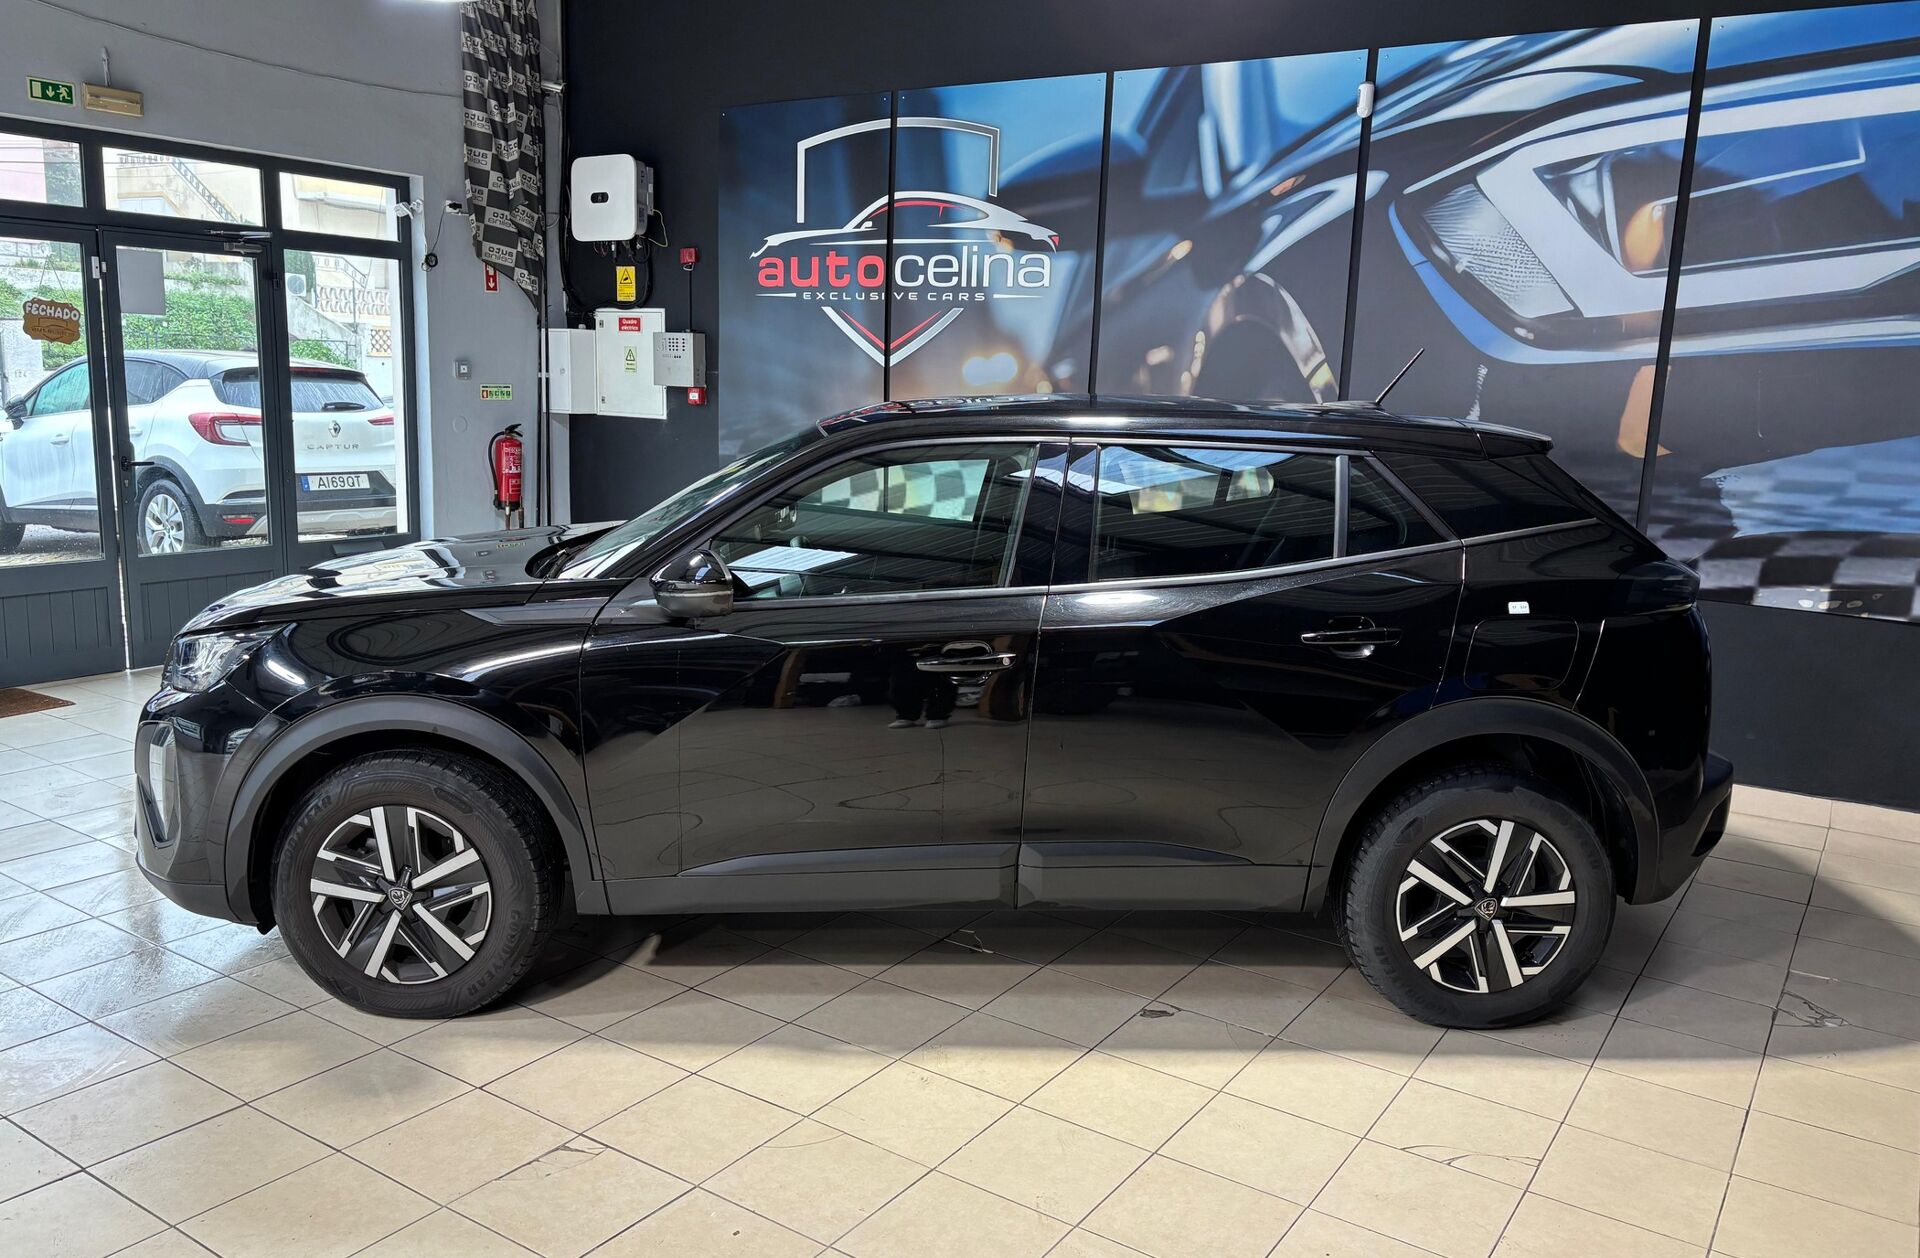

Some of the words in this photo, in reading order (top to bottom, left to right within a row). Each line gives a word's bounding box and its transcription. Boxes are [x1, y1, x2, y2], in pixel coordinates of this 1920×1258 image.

[803, 292, 919, 301] EXCLUSIVE
[927, 292, 985, 301] CARS
[25, 302, 80, 321] FECHADO
